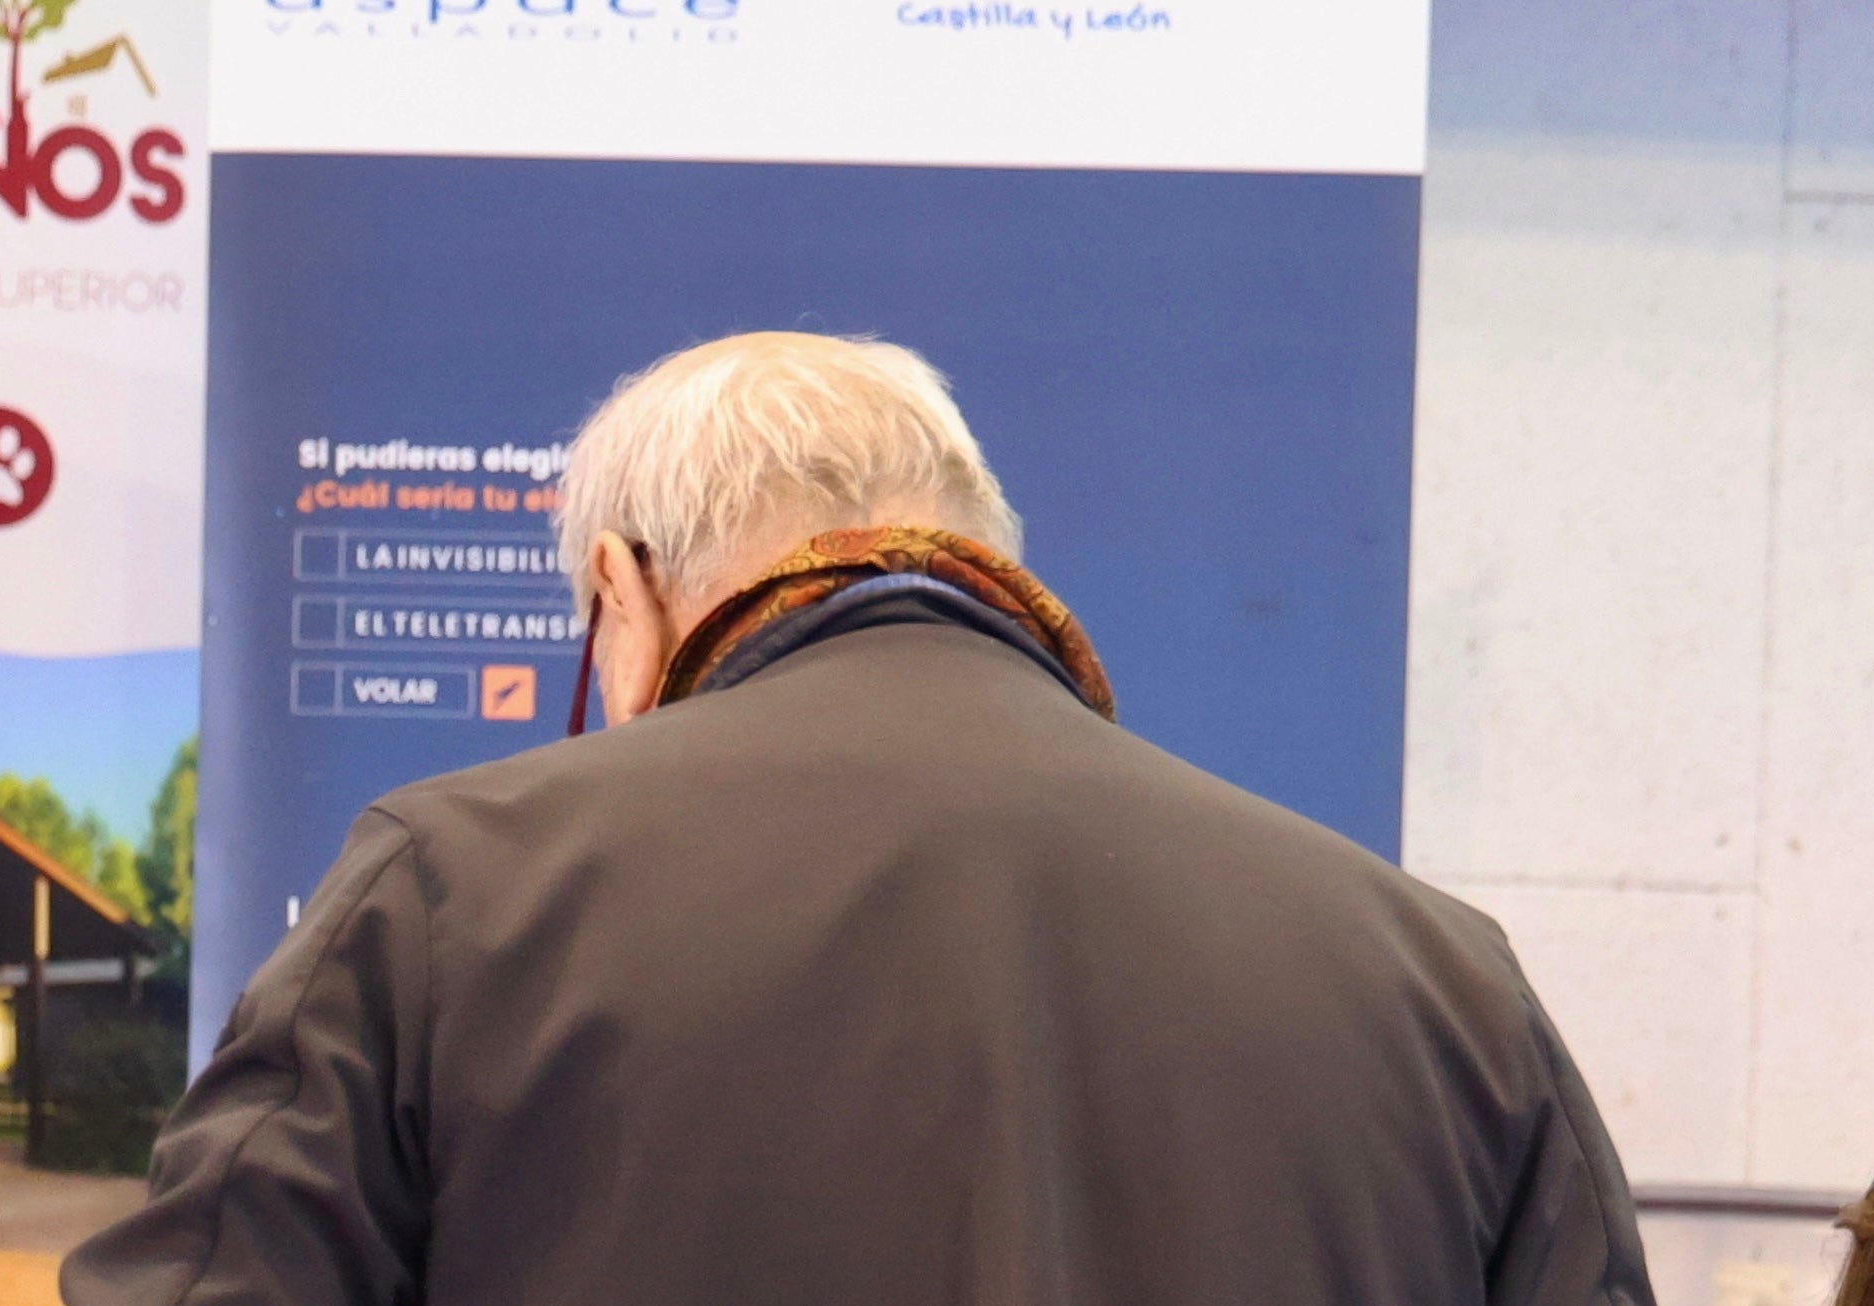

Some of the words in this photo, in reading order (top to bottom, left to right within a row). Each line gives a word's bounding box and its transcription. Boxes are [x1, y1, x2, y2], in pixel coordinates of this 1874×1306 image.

[897, 2, 1037, 31] Castilla
[1049, 10, 1072, 40] y
[1085, 4, 1169, 31] León
[298, 437, 329, 469] Si
[335, 438, 477, 478] pudieras
[482, 484, 517, 512] tu
[355, 543, 394, 571] LA
[354, 609, 387, 637] EL
[353, 675, 439, 705] VOLAR
